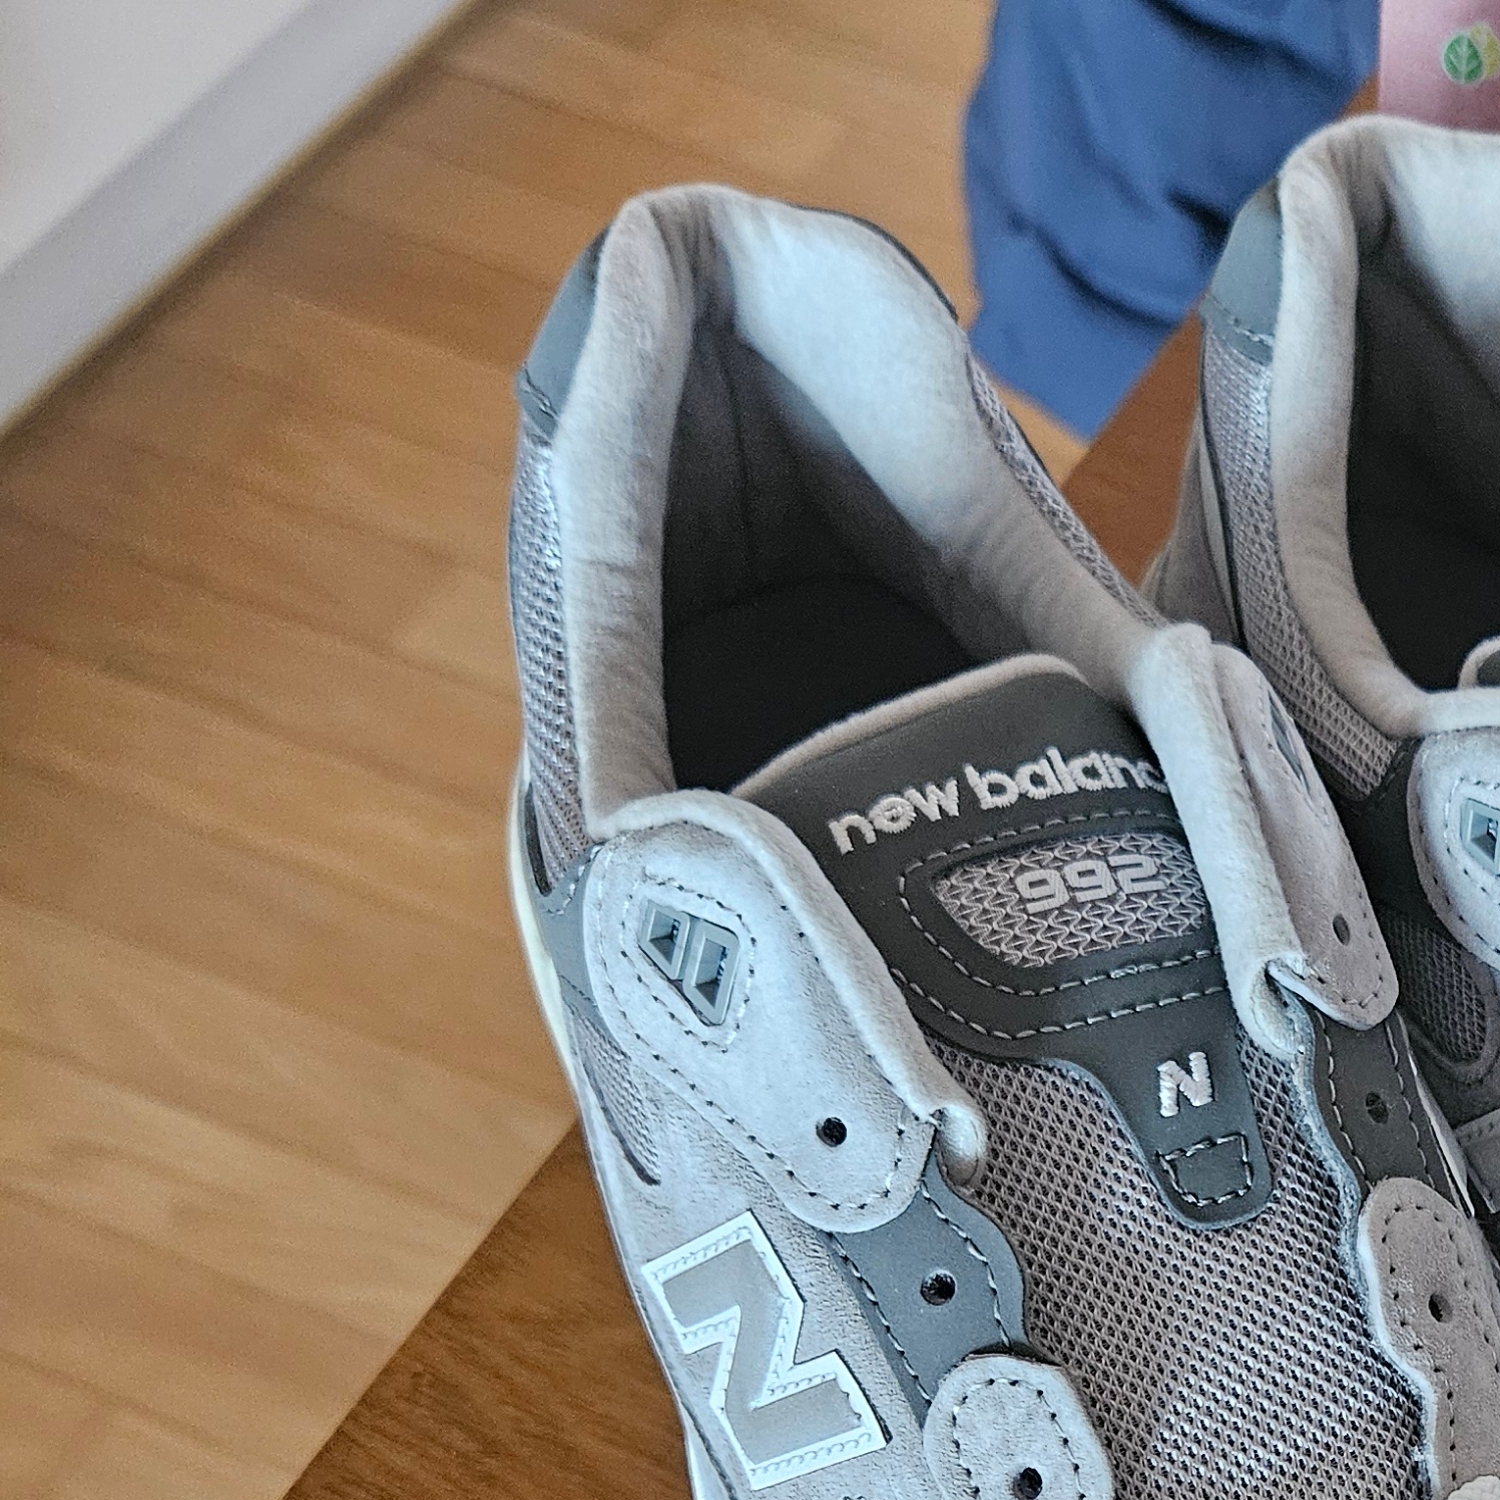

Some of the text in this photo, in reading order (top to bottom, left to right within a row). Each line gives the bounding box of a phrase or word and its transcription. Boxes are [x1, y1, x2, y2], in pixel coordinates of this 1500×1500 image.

[827, 777, 961, 856] new
[1013, 853, 1169, 915] 992
[1156, 1050, 1214, 1119] N
[640, 1209, 890, 1492] N
